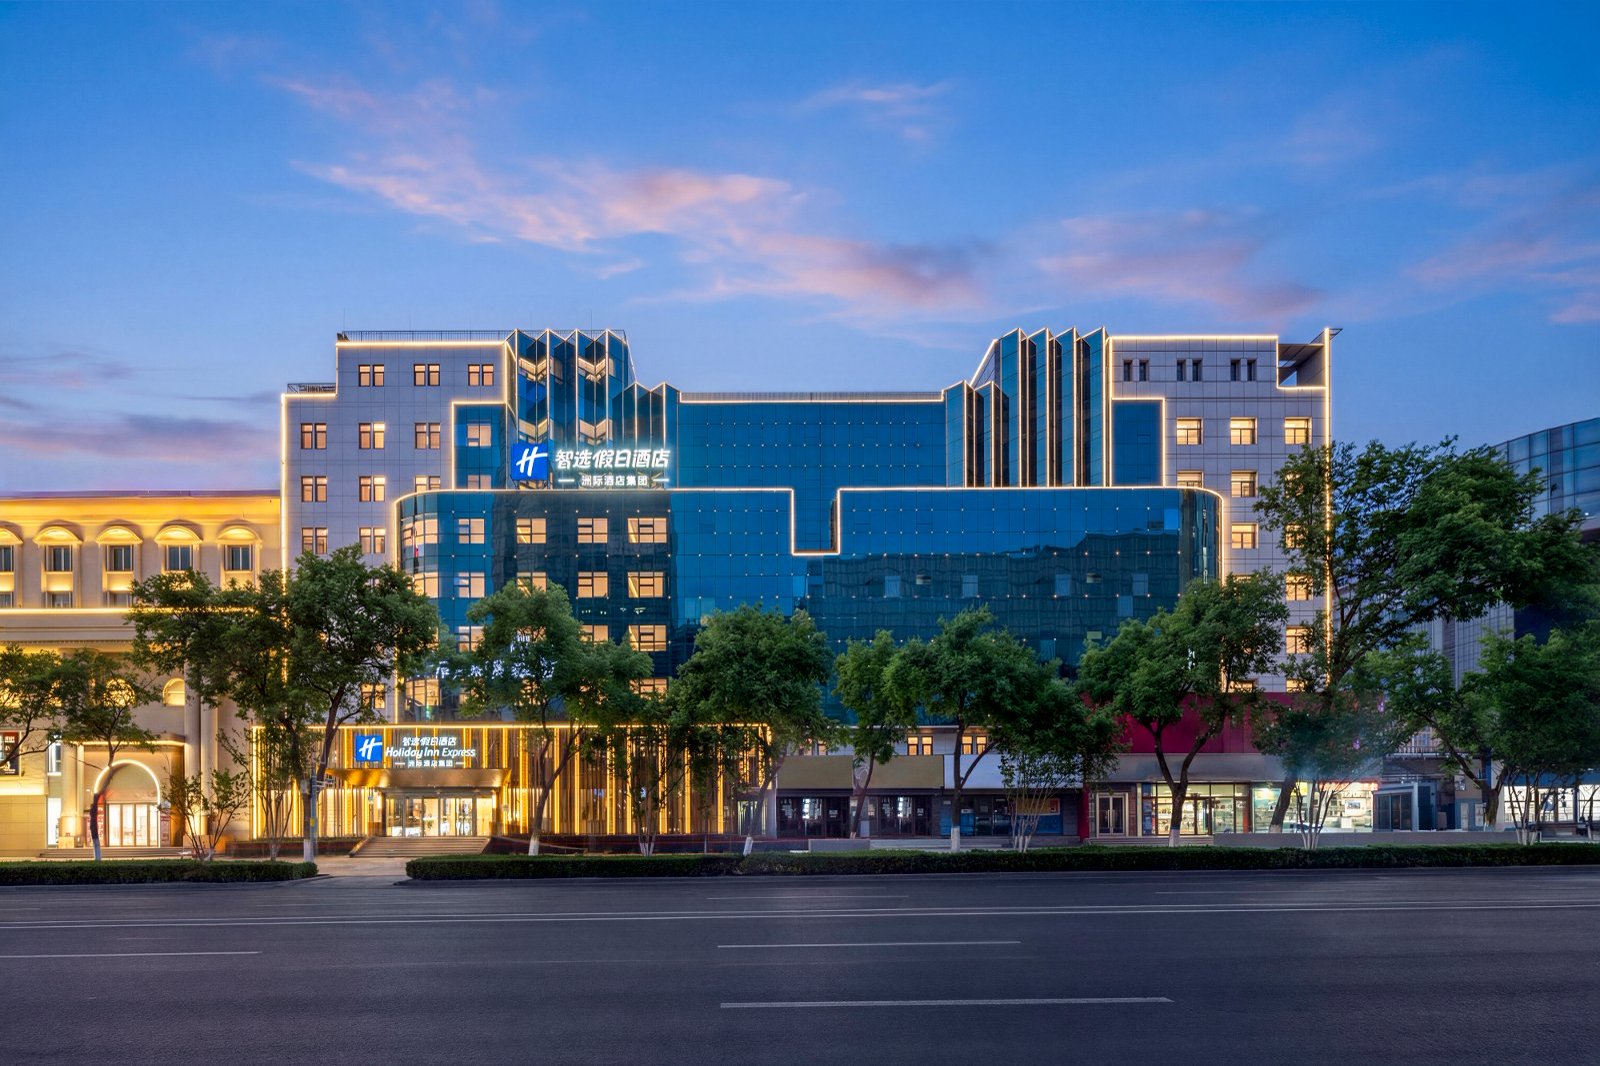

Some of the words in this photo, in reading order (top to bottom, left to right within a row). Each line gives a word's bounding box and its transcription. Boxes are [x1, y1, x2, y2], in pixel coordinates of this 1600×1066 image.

[555, 449, 671, 470] 智选假日酒店
[581, 475, 648, 487] 洲际酒店集团
[402, 736, 457, 747] 智选假日酒店
[386, 747, 423, 759] Holiday
[424, 747, 439, 757] Inn
[442, 747, 476, 759] Express
